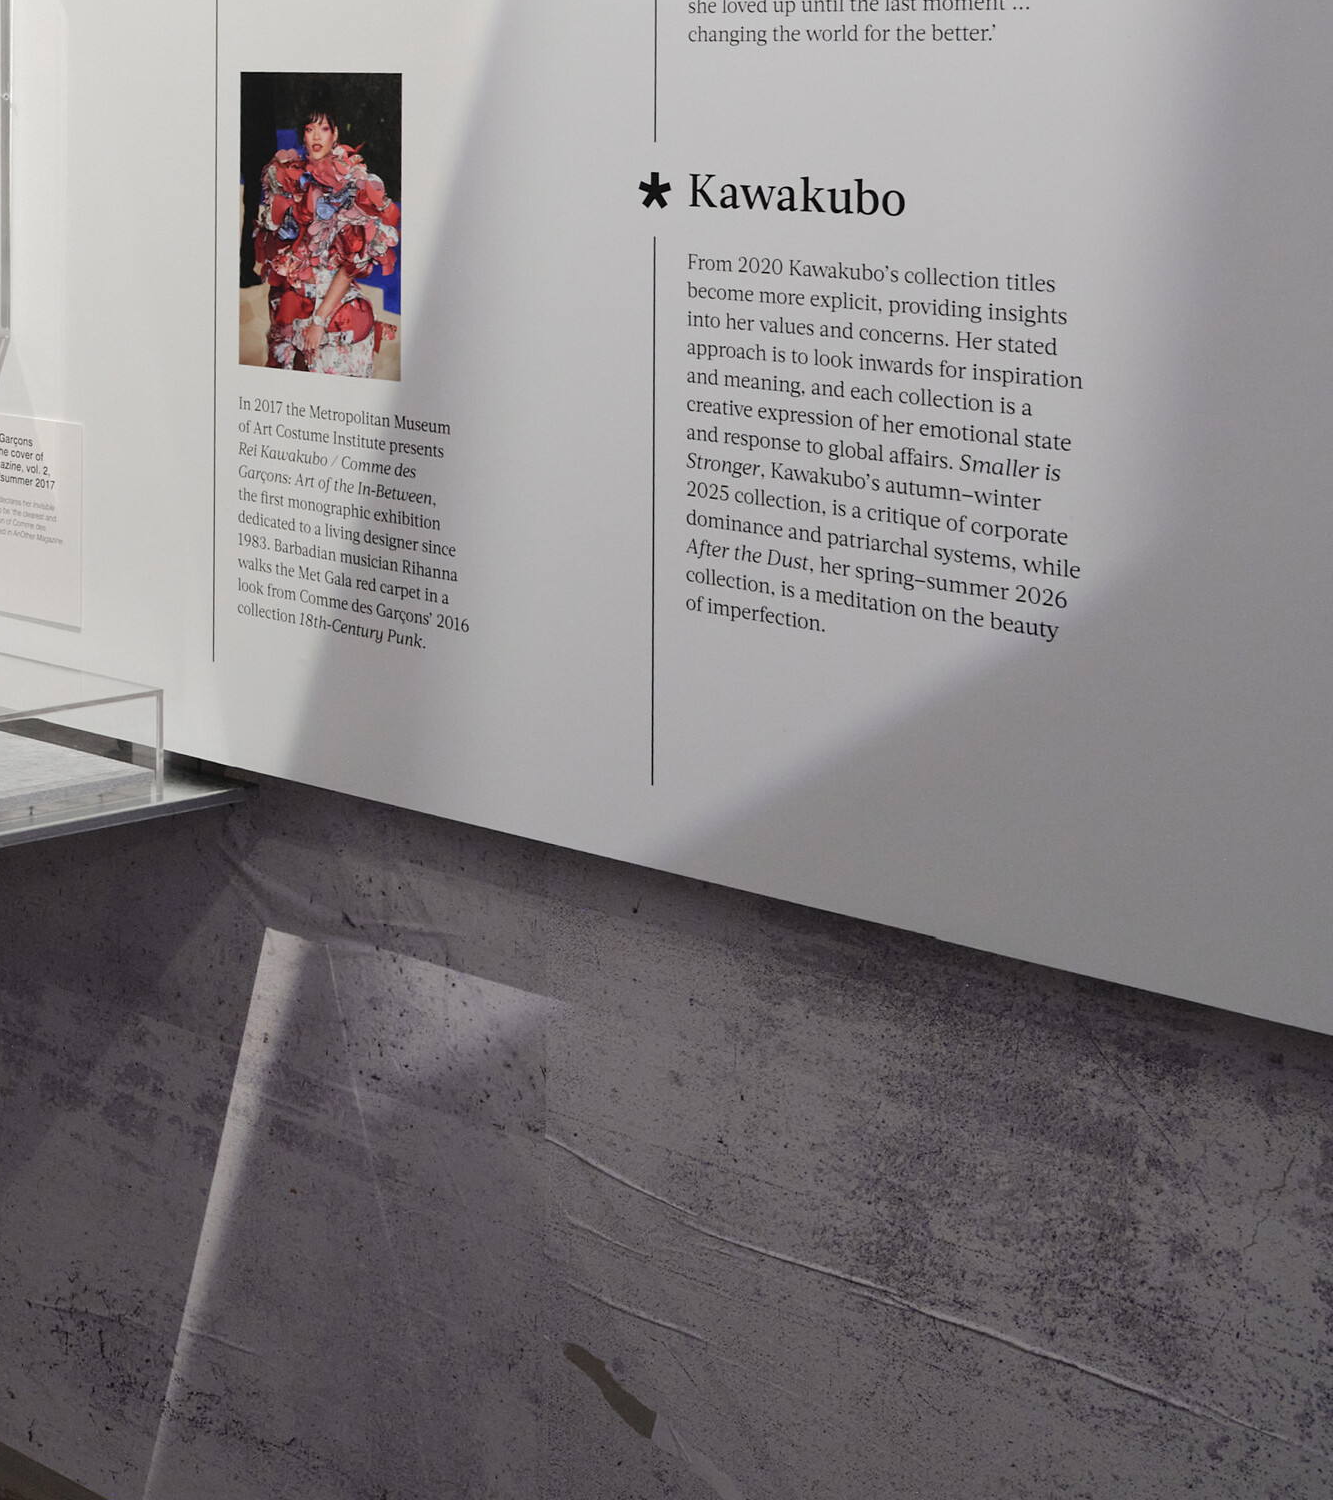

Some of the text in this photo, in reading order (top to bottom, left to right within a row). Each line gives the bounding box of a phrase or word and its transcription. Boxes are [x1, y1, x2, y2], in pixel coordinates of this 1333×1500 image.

[689, 174, 905, 216] Kawakubo
[688, 254, 1055, 292] From 2020 Kawakubo’s collection titles
[239, 397, 450, 434] In 2017 the Metropolitan Museum
[0, 433, 33, 447] Garçons
